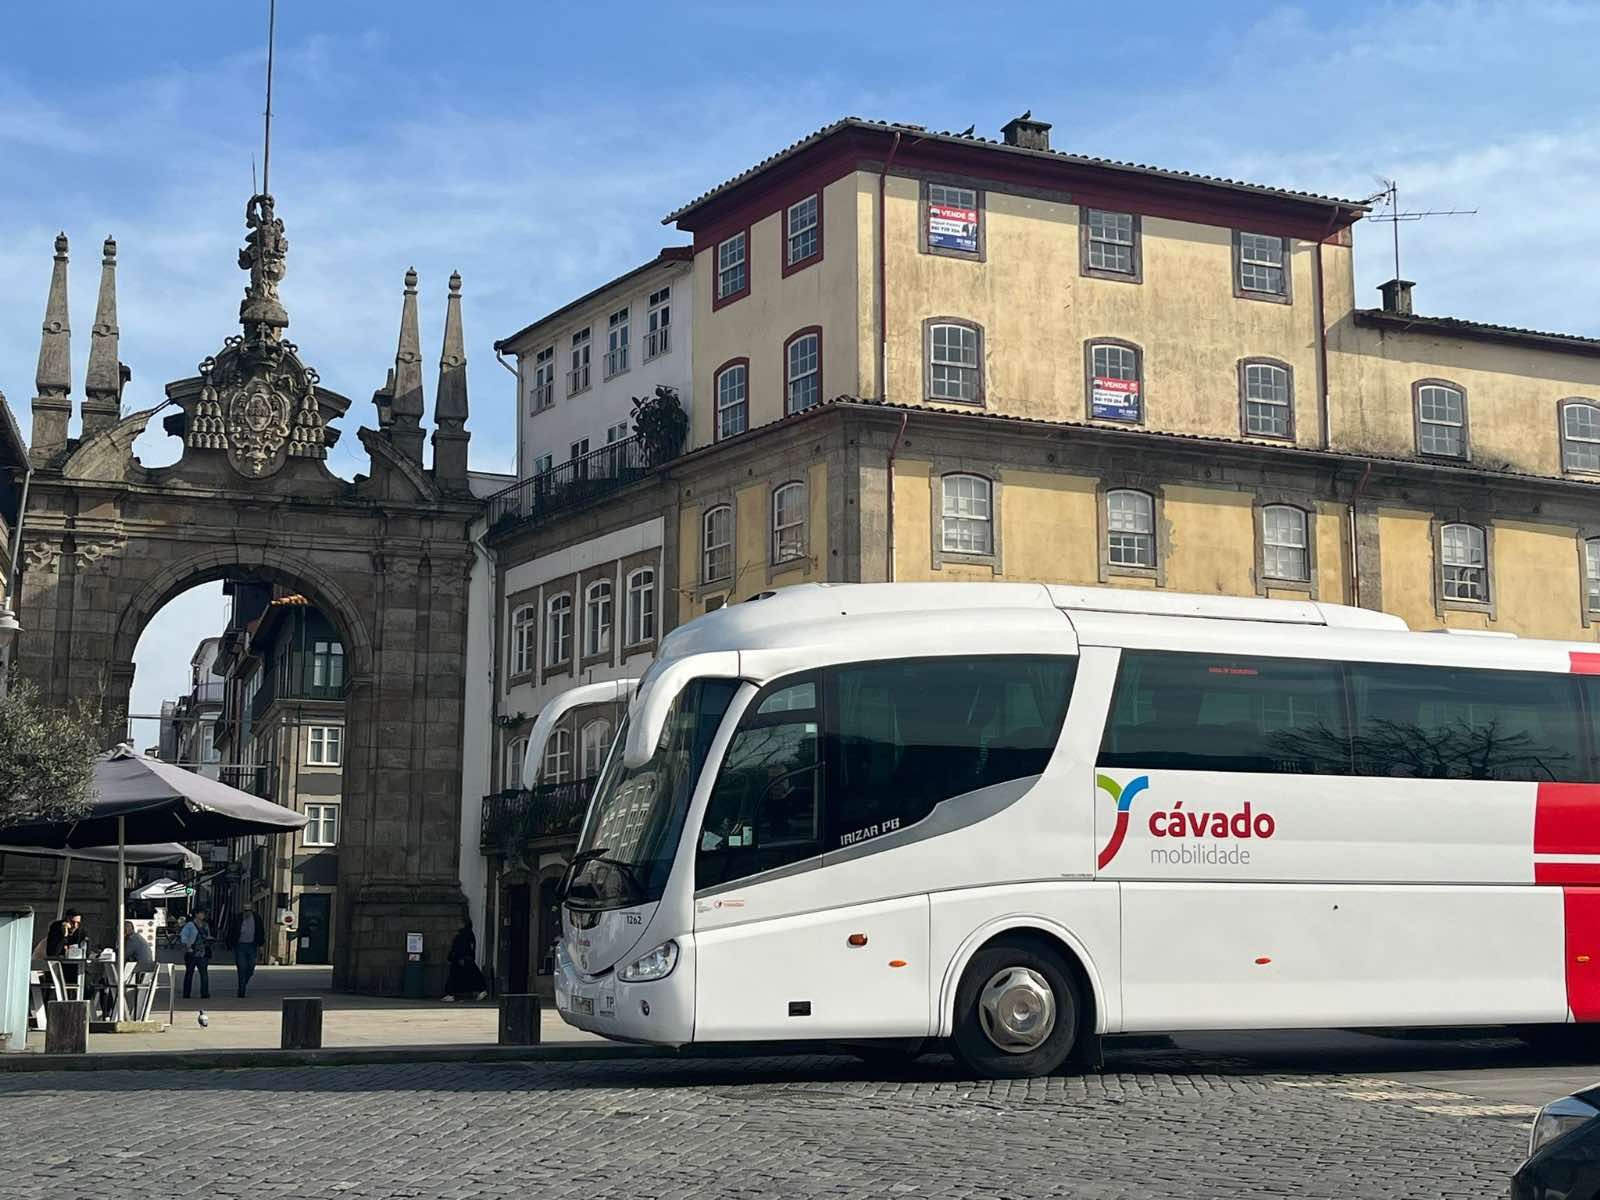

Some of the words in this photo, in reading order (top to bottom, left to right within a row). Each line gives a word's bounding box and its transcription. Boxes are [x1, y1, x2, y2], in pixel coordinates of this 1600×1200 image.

[941, 210, 966, 219] VENDE
[1103, 381, 1128, 389] VENDE
[1148, 801, 1276, 839] cávado
[840, 824, 879, 846] IRIZAR
[1150, 843, 1250, 865] mobilidade
[626, 915, 642, 925] 1262
